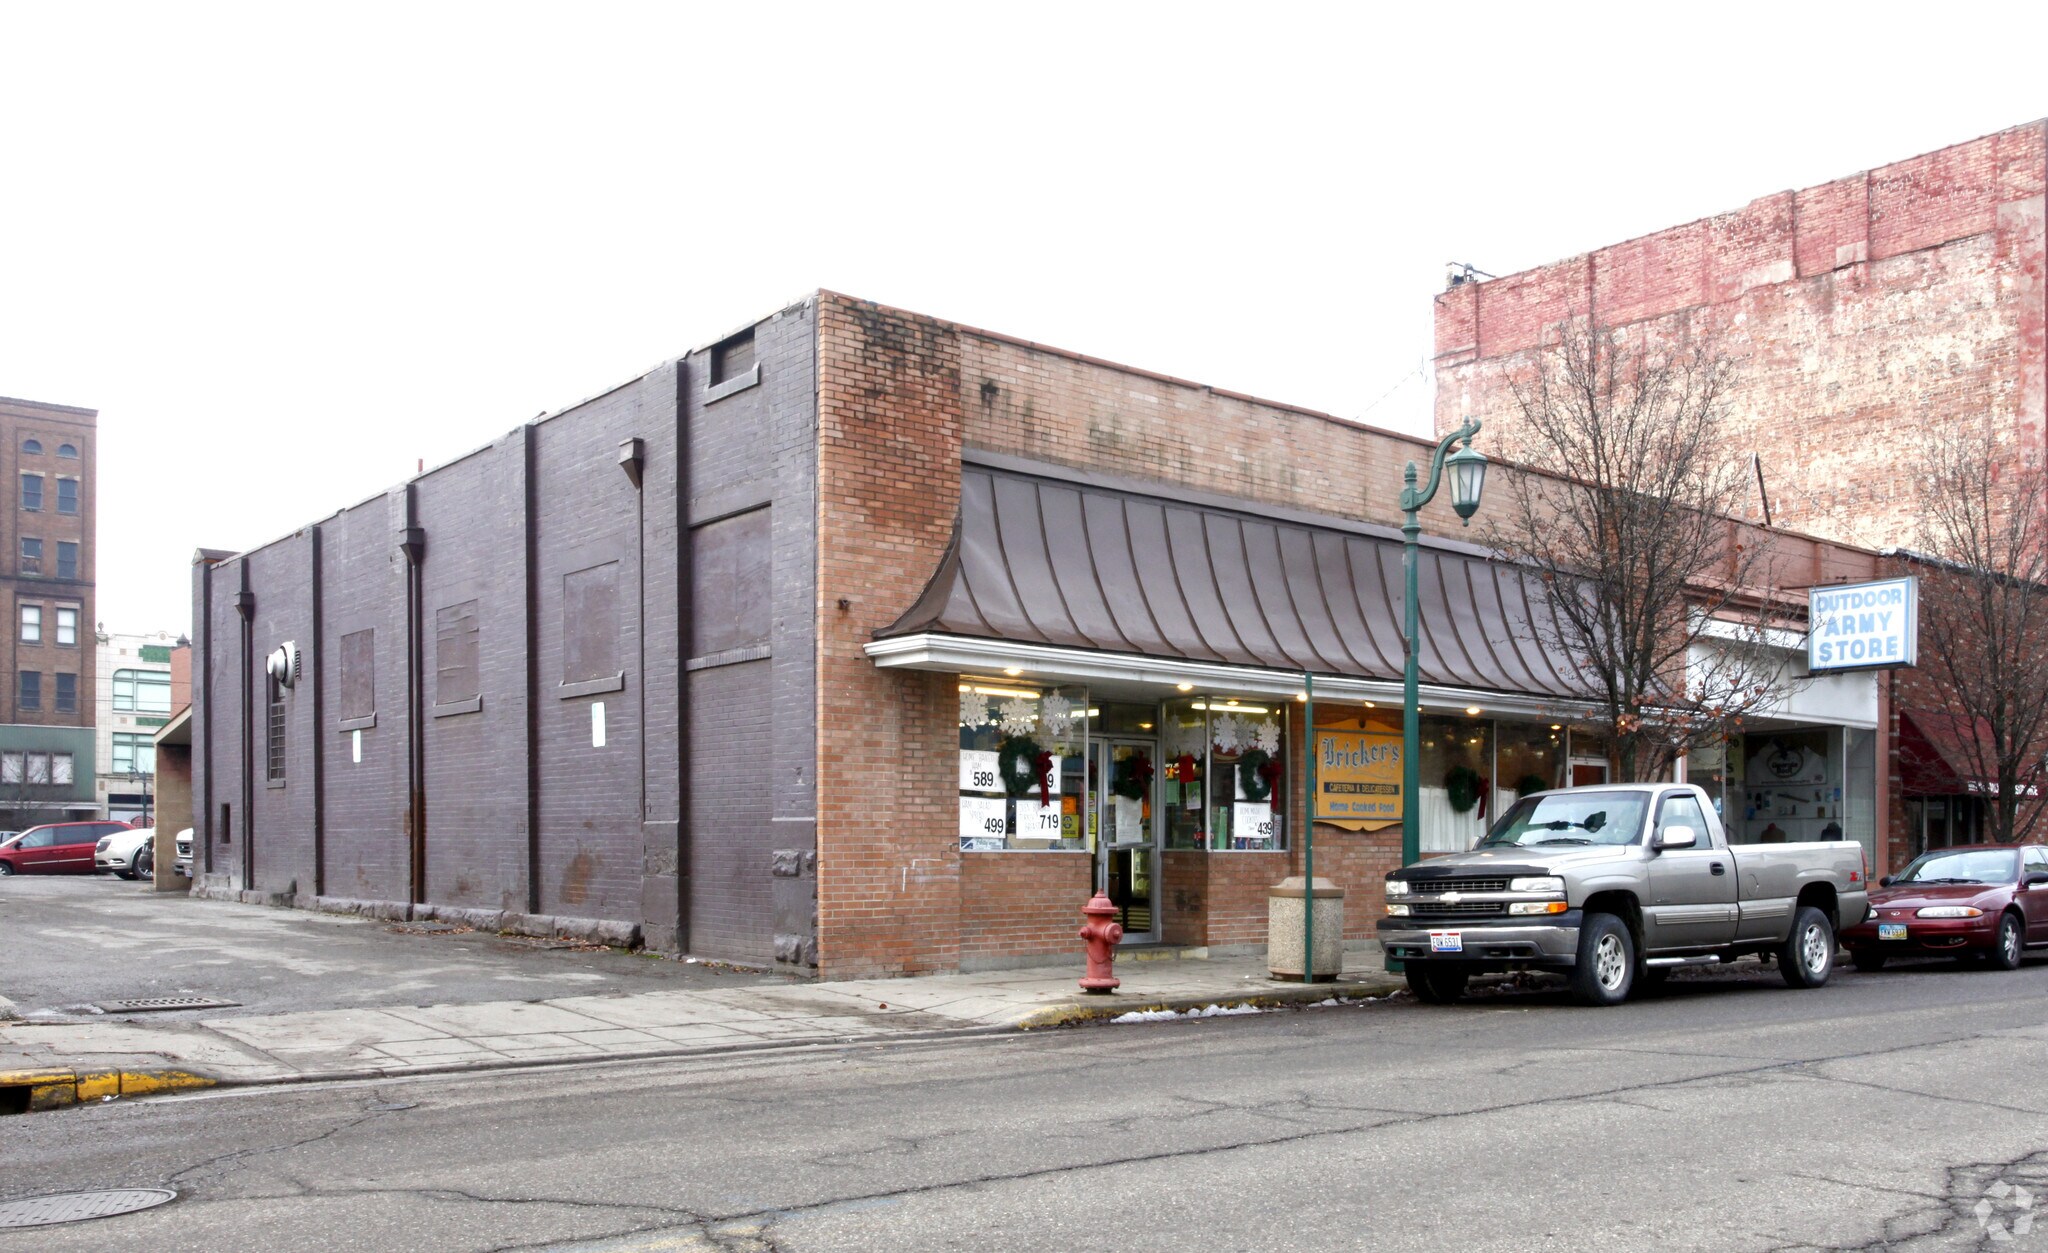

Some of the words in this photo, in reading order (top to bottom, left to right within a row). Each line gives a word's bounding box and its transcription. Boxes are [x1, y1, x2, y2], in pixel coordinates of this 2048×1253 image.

[1815, 588, 1902, 612] OUTDOOR
[1824, 611, 1892, 637] ARMY
[1819, 636, 1898, 662] STORE
[1322, 736, 1400, 770] Bricker's
[973, 771, 994, 787] 589
[1329, 783, 1355, 793] CAFETERIA
[1361, 784, 1395, 794] DELICATESSEN
[1329, 802, 1348, 812] Home
[1352, 802, 1376, 812] Cooked
[1379, 803, 1395, 812] Food
[984, 817, 1004, 834] 499
[1040, 814, 1059, 829] 719
[1257, 821, 1272, 835] 439
